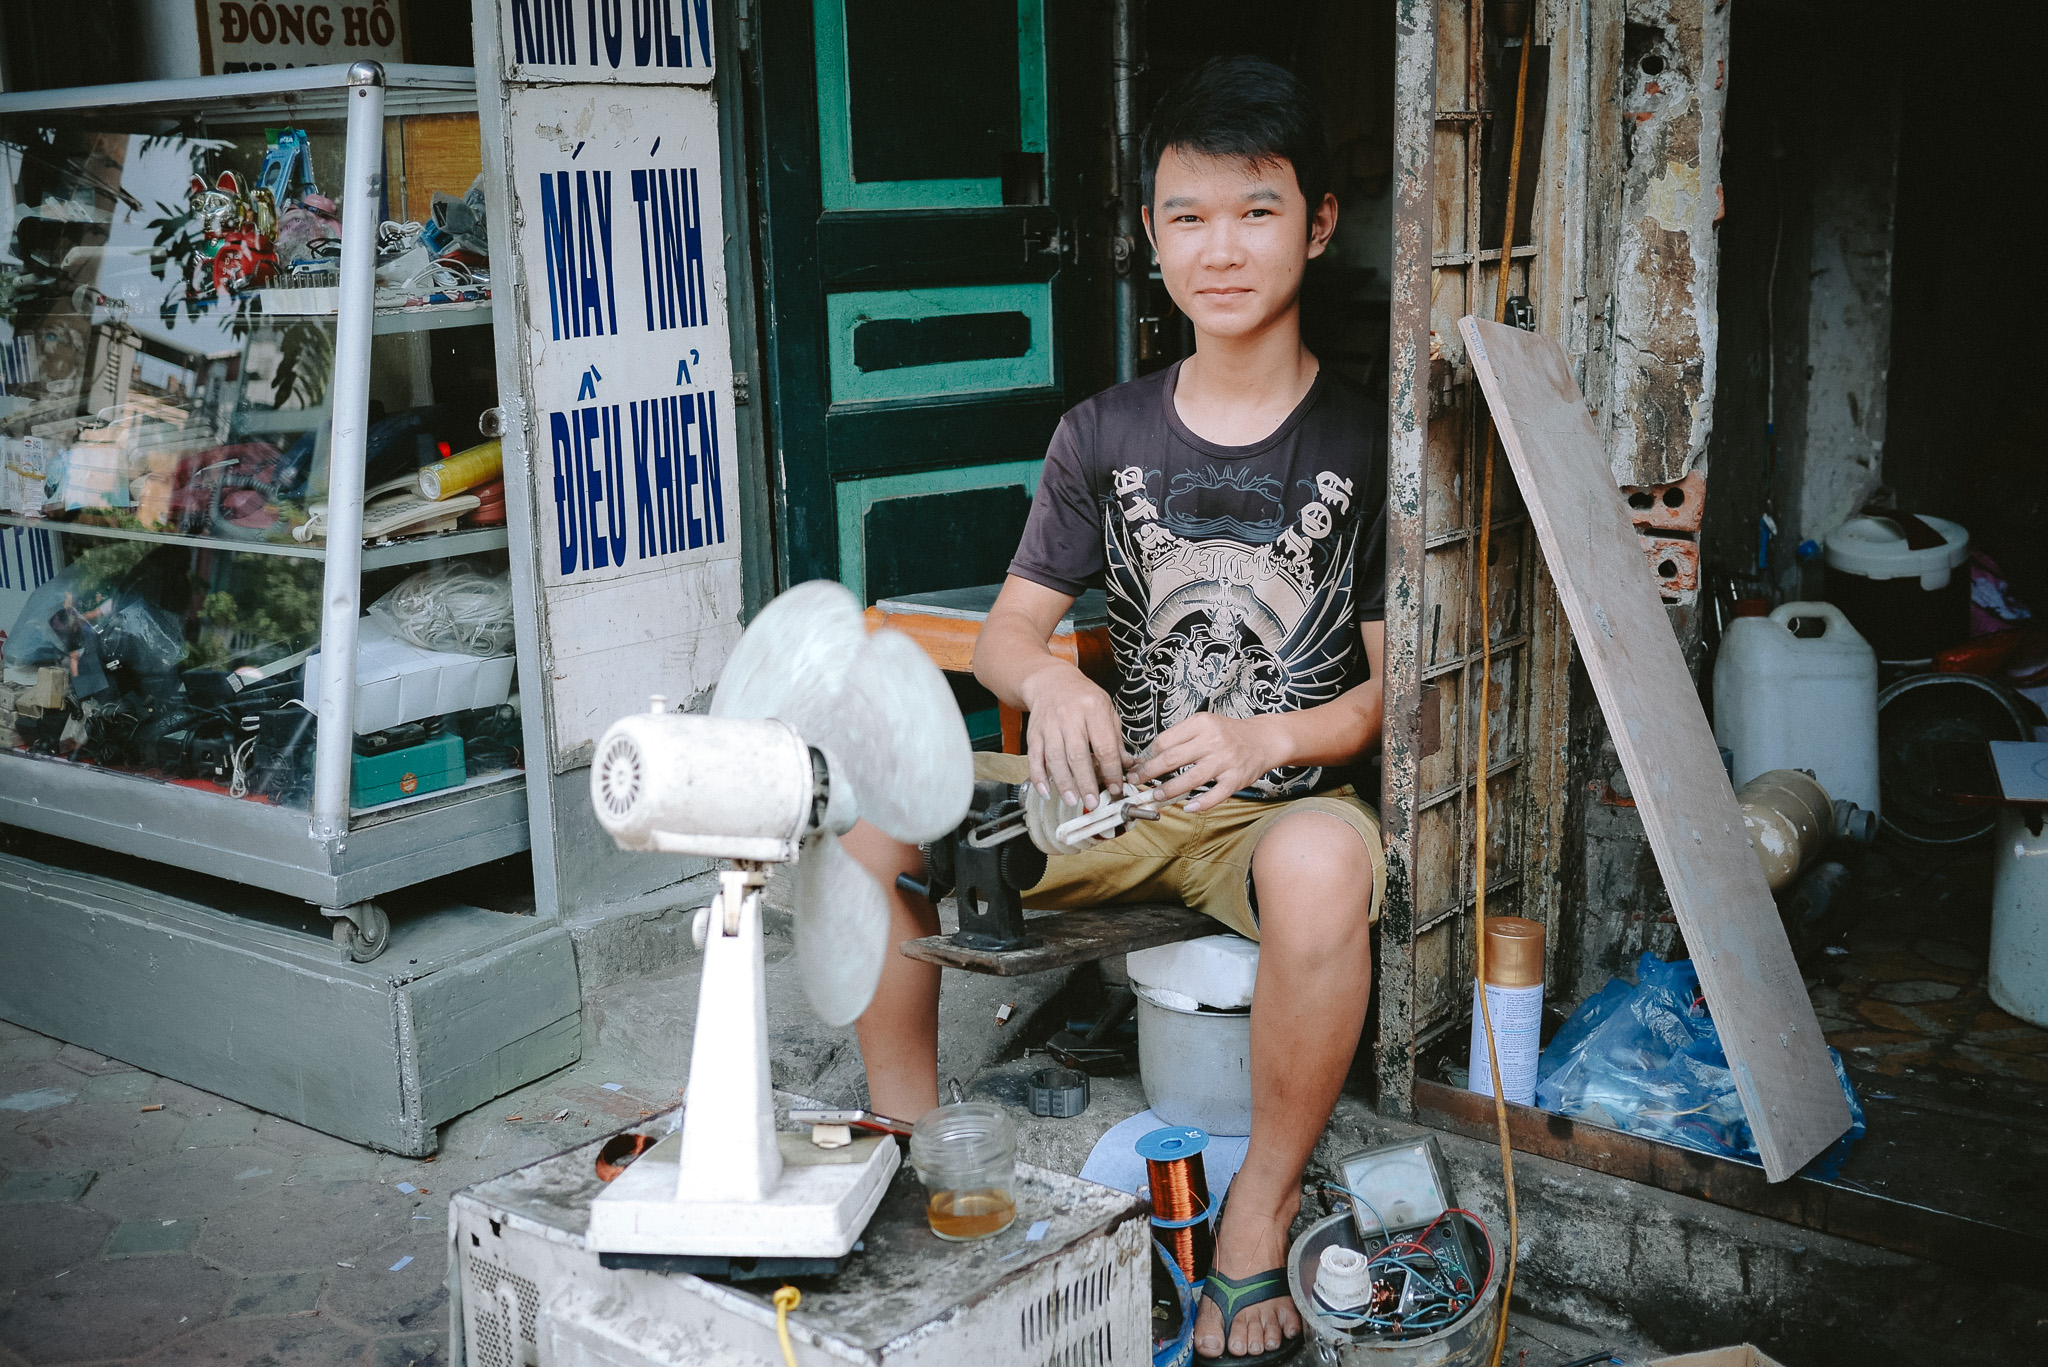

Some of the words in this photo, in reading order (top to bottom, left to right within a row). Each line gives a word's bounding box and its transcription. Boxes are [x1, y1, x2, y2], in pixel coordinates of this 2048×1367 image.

[540, 141, 618, 341] MÁY
[630, 136, 708, 331] TÍNH
[550, 364, 627, 575] ĐIỀU
[629, 348, 725, 560] KHIỂN
